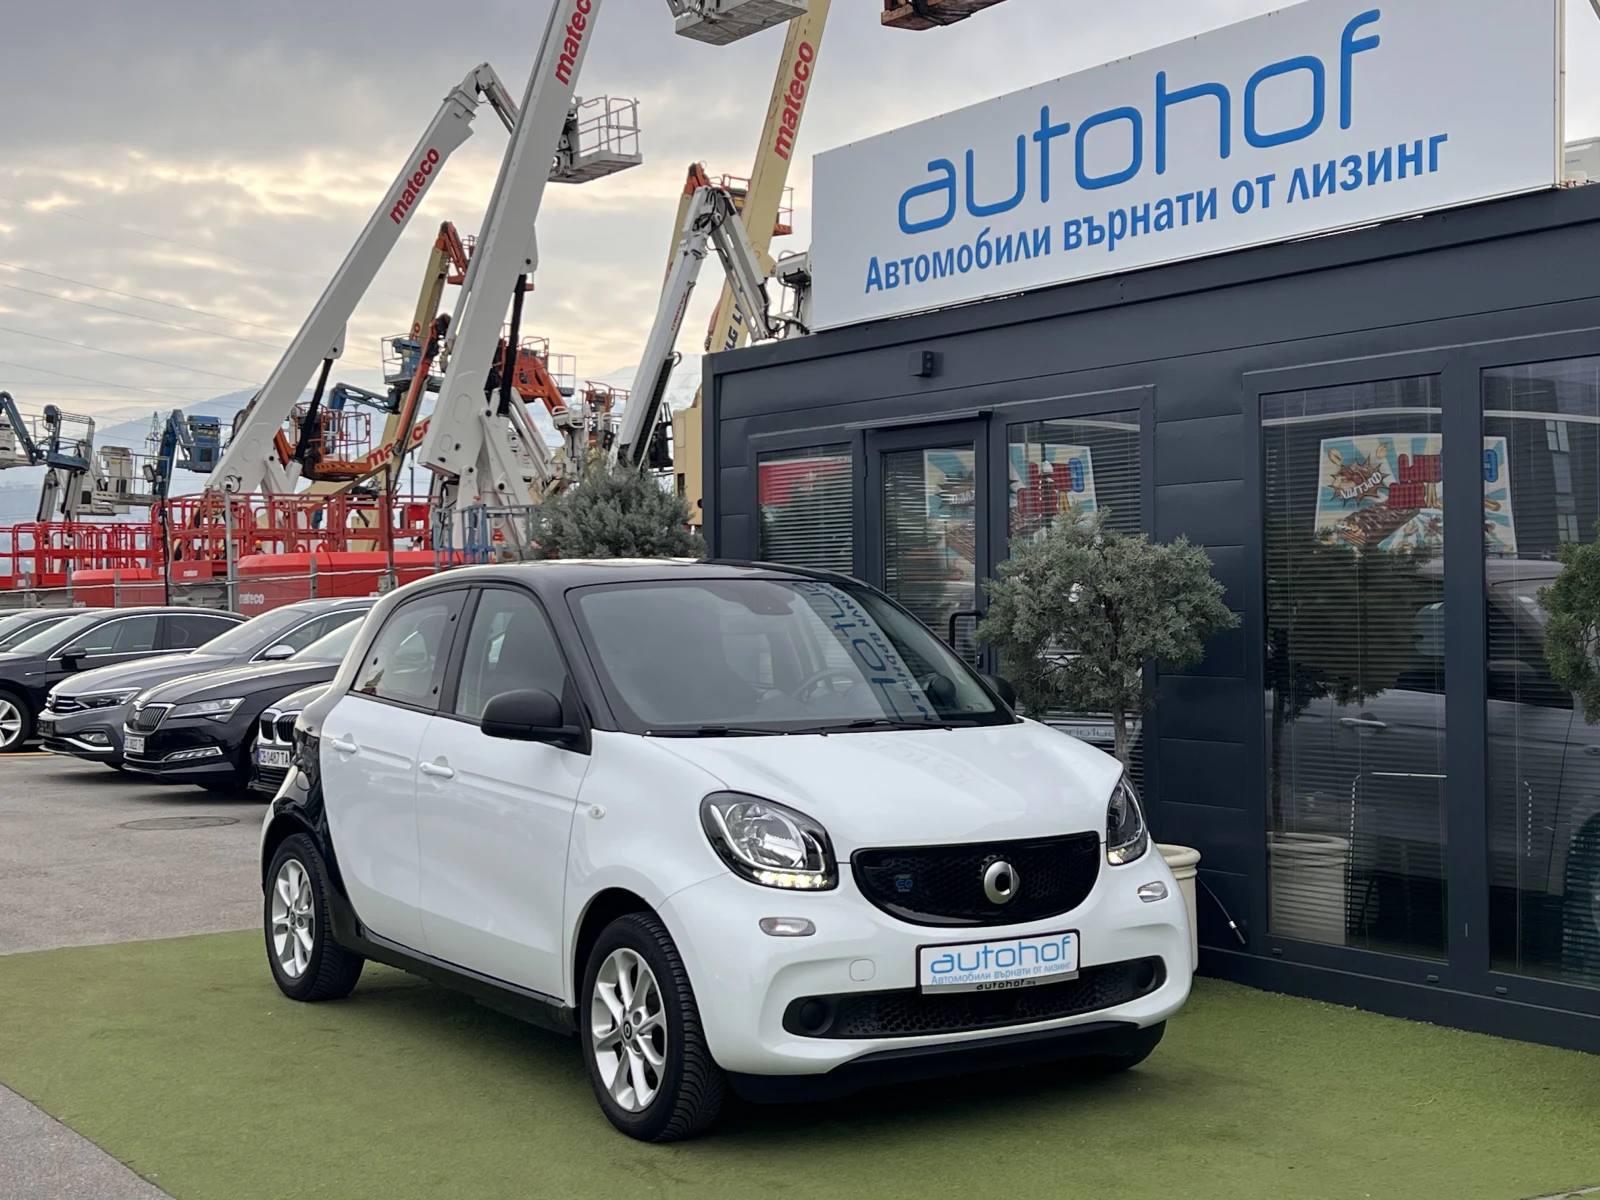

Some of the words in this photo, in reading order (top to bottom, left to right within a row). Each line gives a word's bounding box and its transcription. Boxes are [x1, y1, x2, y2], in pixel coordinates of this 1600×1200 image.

[774, 41, 814, 161] mateco
[898, 10, 1380, 235] autohof
[390, 148, 440, 225] mateco
[866, 227, 1051, 293] Автомобили
[1063, 188, 1217, 252] върнати
[1231, 174, 1276, 214] от
[1287, 134, 1447, 204] лизинг
[895, 879, 914, 889] EQ
[930, 935, 1071, 974] autohof
[931, 972, 991, 985] Автомобили
[994, 966, 1031, 981] върнати
[1033, 966, 1042, 975] от
[1044, 961, 1071, 973] лизинг
